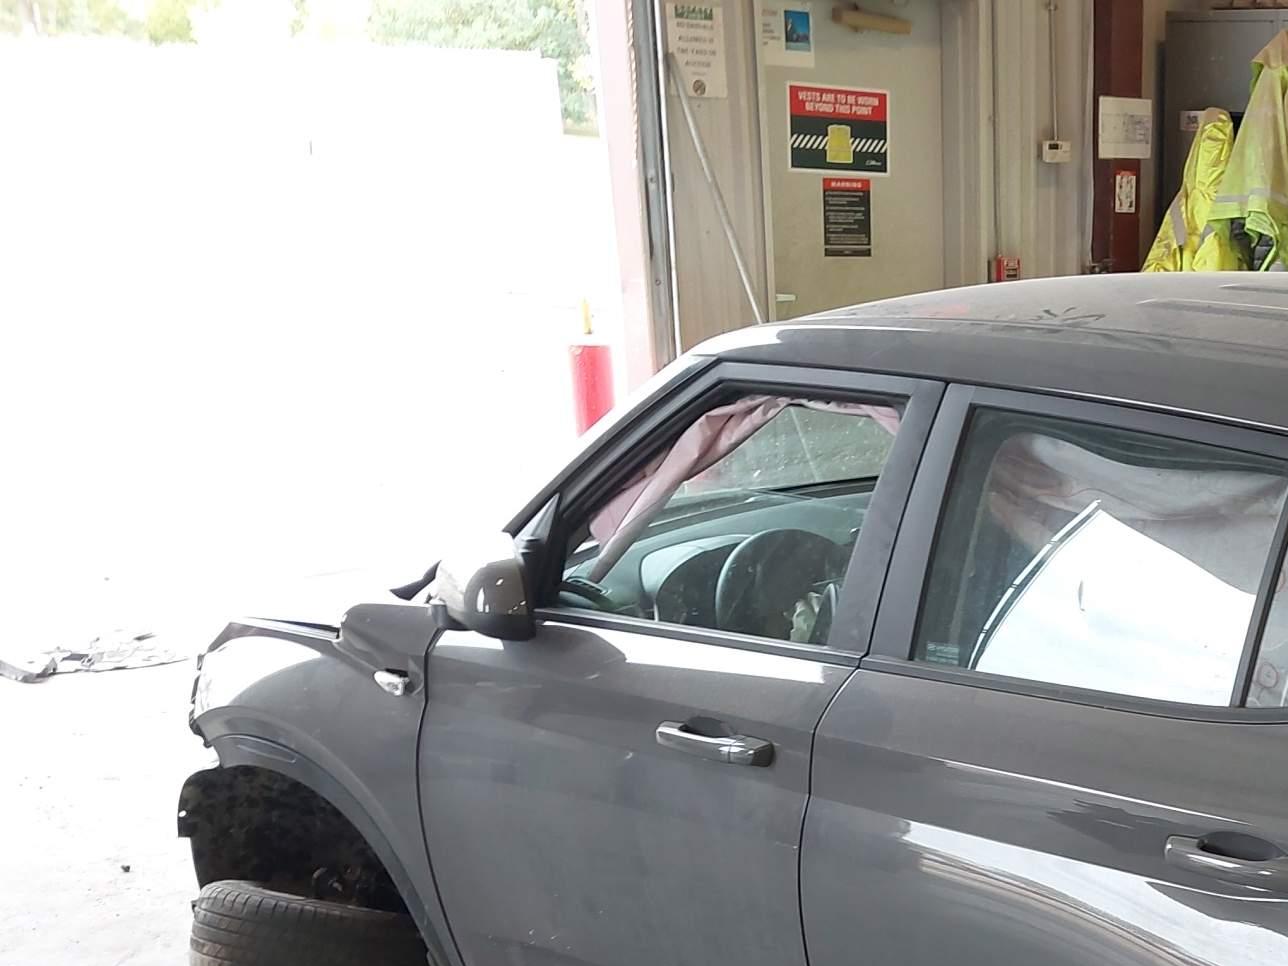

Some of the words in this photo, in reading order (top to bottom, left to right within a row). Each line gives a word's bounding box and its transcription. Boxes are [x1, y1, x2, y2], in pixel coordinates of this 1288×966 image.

[798, 91, 820, 101] VESTS
[822, 92, 835, 103] ARE
[837, 94, 846, 104] TO
[847, 95, 856, 105] BE
